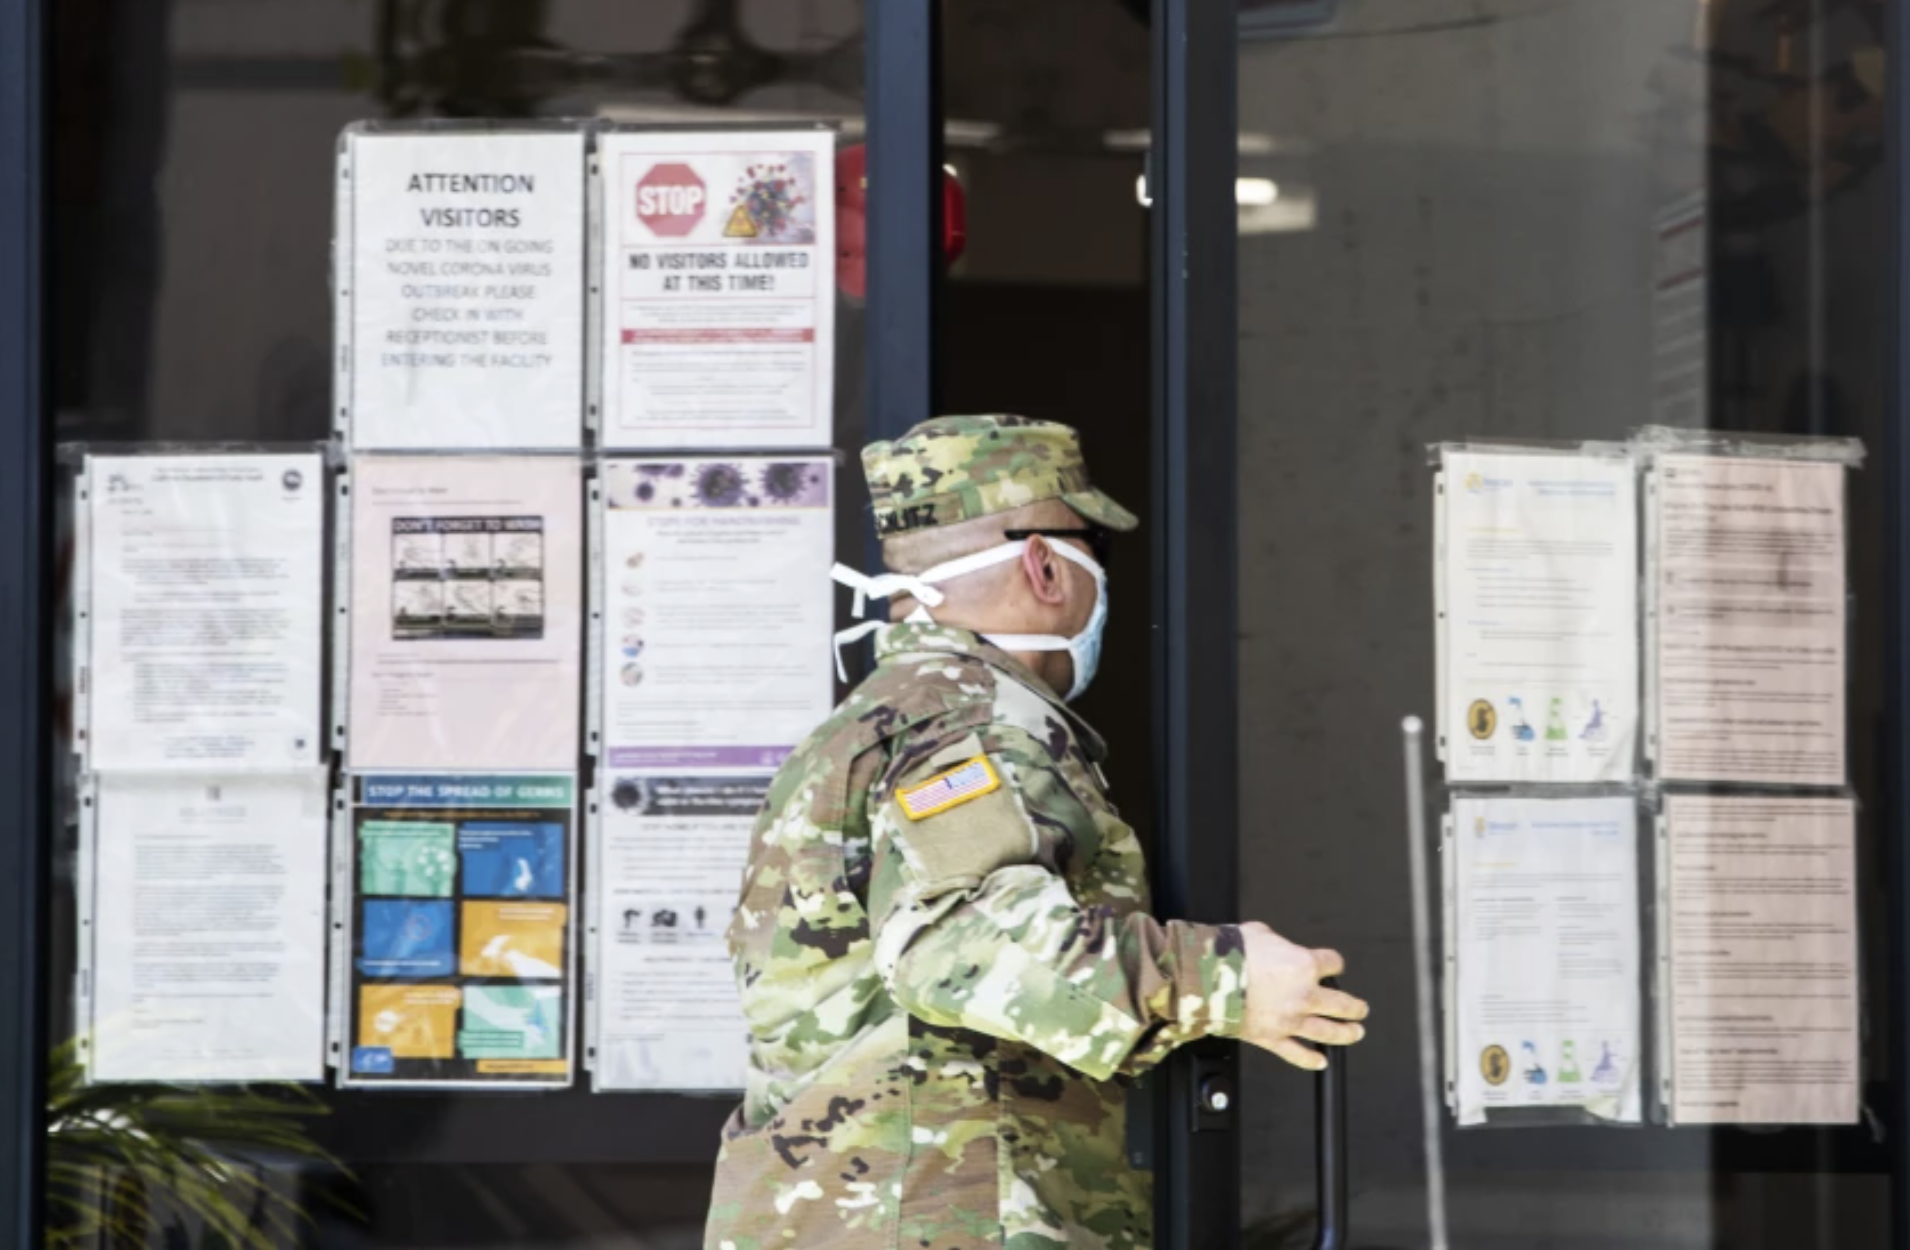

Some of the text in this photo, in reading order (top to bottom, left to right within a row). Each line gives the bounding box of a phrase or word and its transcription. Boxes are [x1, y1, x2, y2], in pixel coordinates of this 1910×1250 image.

[407, 173, 534, 193] ATTENTION
[638, 184, 704, 216] STOP
[420, 207, 521, 227] VISITORS
[385, 239, 554, 253] DUE TO THE ON GOING
[628, 251, 810, 270] NO VISITORS ALLOWED
[386, 262, 553, 276] NOVEL CORONA VIRUS
[661, 275, 680, 291] AT
[688, 275, 722, 291] THIS
[401, 284, 537, 299] OUTBREAK PLEASE
[411, 308, 525, 322] CHECK IN WITH
[385, 330, 549, 345] RECEPTIONIST BEFORE
[381, 353, 554, 368] ENTERING THE FACILITY
[368, 784, 405, 797] STOP
[408, 784, 433, 797] THE
[438, 784, 492, 797] SPREAD
[495, 785, 512, 797] OF
